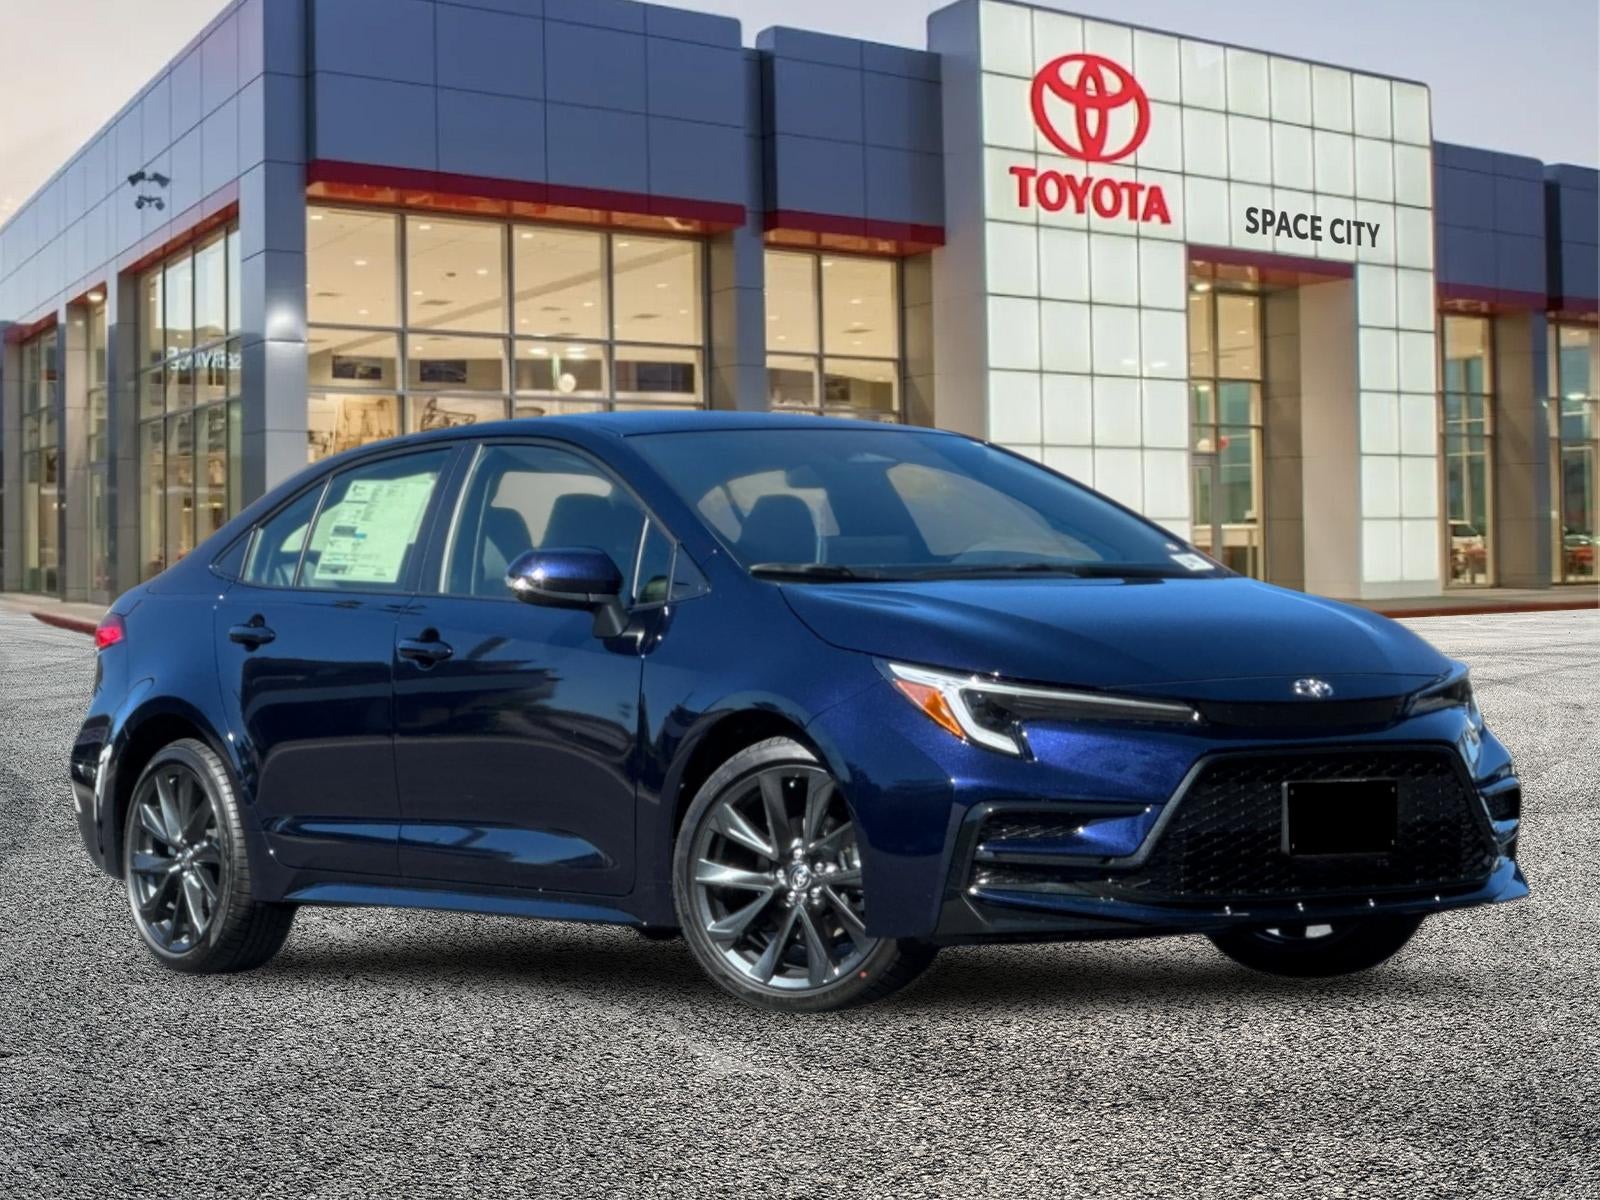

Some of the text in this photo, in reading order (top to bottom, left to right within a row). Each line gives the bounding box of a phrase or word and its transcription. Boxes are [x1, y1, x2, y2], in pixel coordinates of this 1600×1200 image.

[1009, 166, 1171, 225] TOYOTA
[1245, 206, 1381, 248] SPACE CITY
